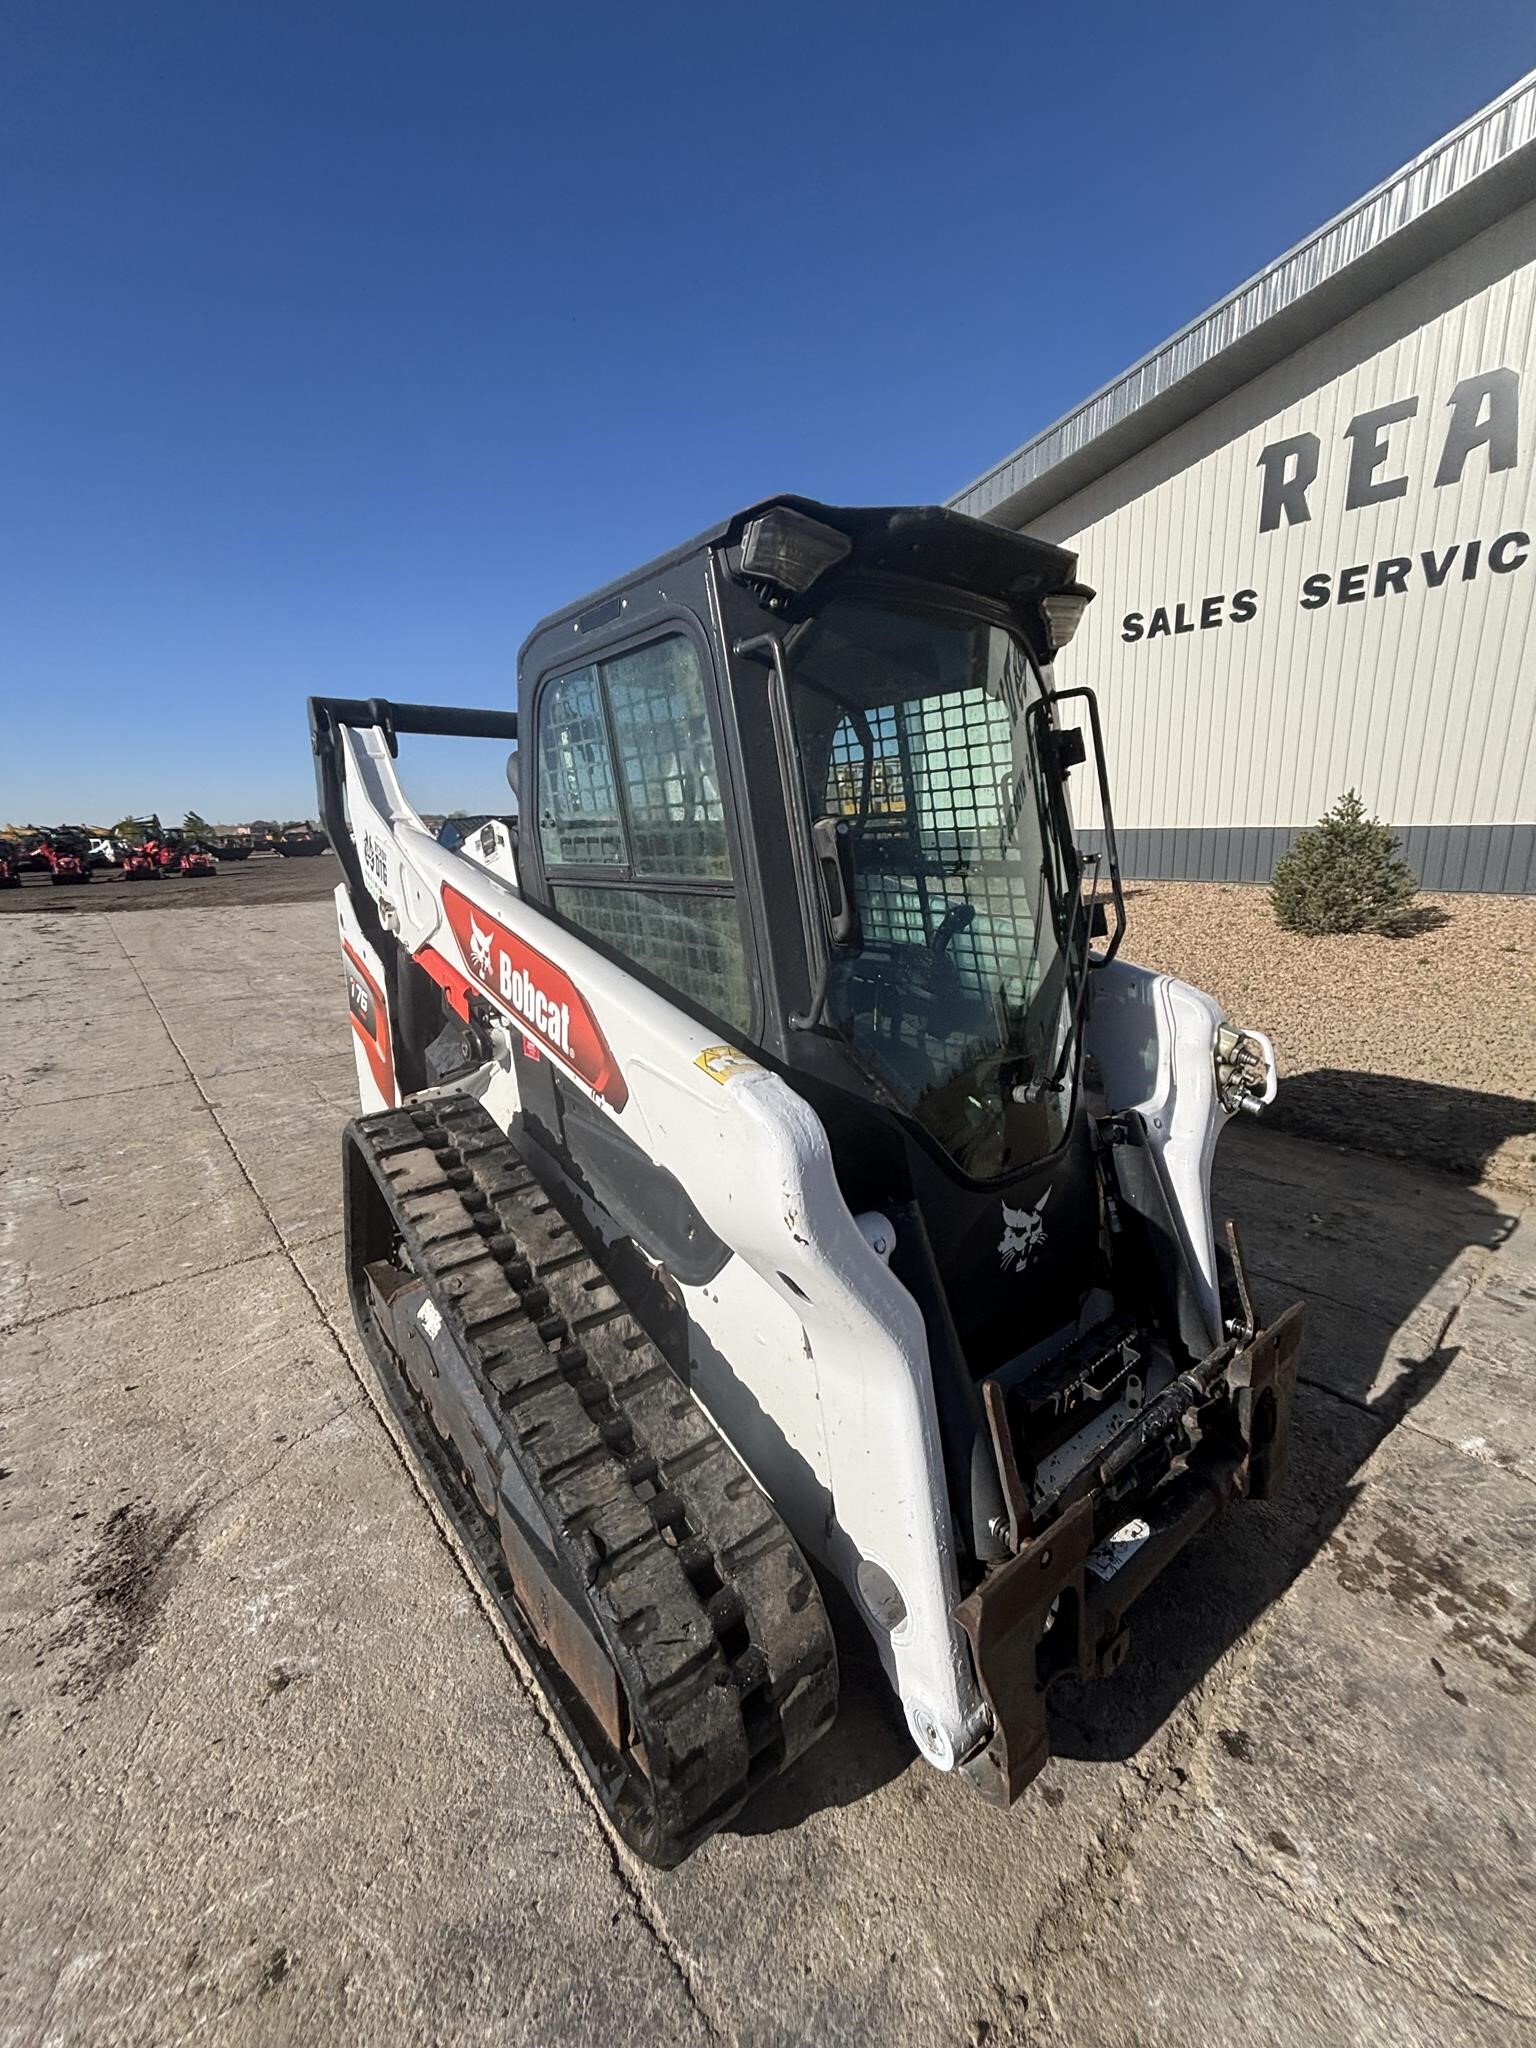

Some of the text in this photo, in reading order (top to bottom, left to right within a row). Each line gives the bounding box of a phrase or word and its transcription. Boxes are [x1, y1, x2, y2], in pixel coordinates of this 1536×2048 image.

[1256, 367, 1520, 534] REA
[1121, 531, 1531, 643] SALES SERVIC
[499, 949, 570, 1056] Bobcat
